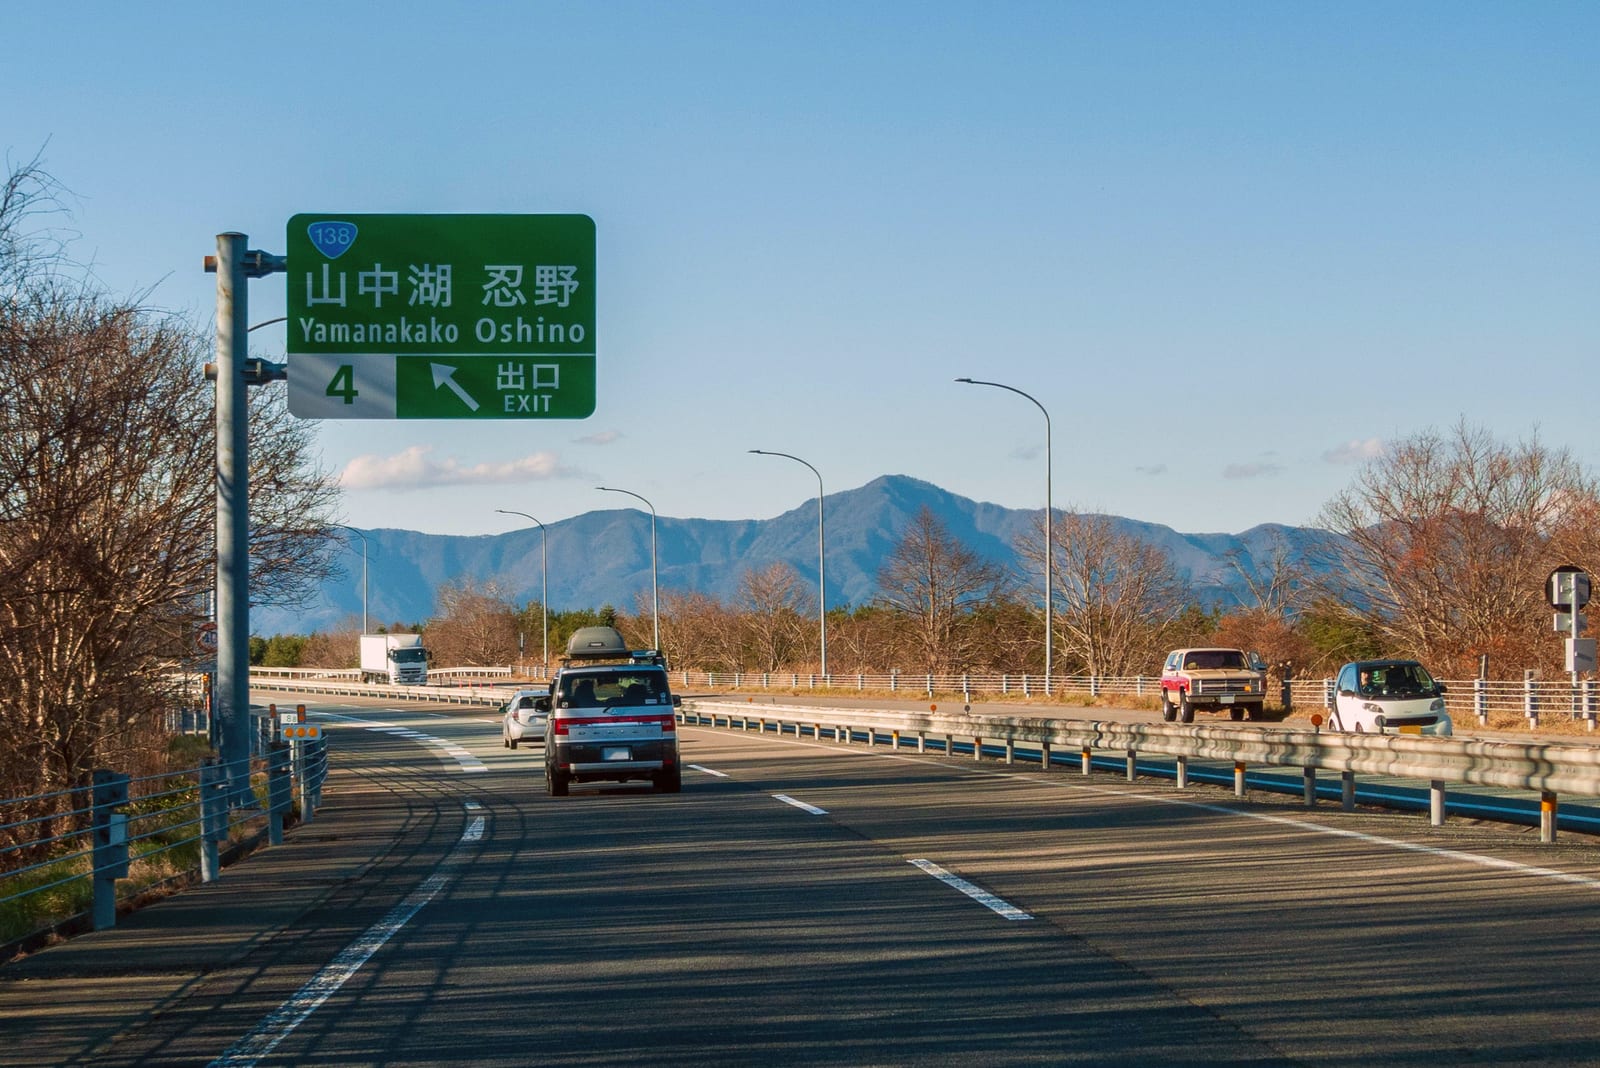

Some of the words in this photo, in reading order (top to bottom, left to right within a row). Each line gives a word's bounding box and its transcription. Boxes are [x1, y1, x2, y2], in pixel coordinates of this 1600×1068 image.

[315, 228, 349, 245] 138
[306, 263, 452, 308] 山中湖
[481, 265, 580, 308] 忍野
[300, 317, 459, 343] Yamanakako
[475, 318, 585, 343] Oshino
[326, 365, 358, 405] 4
[497, 362, 560, 390] 出口
[504, 395, 553, 412] EXIT
